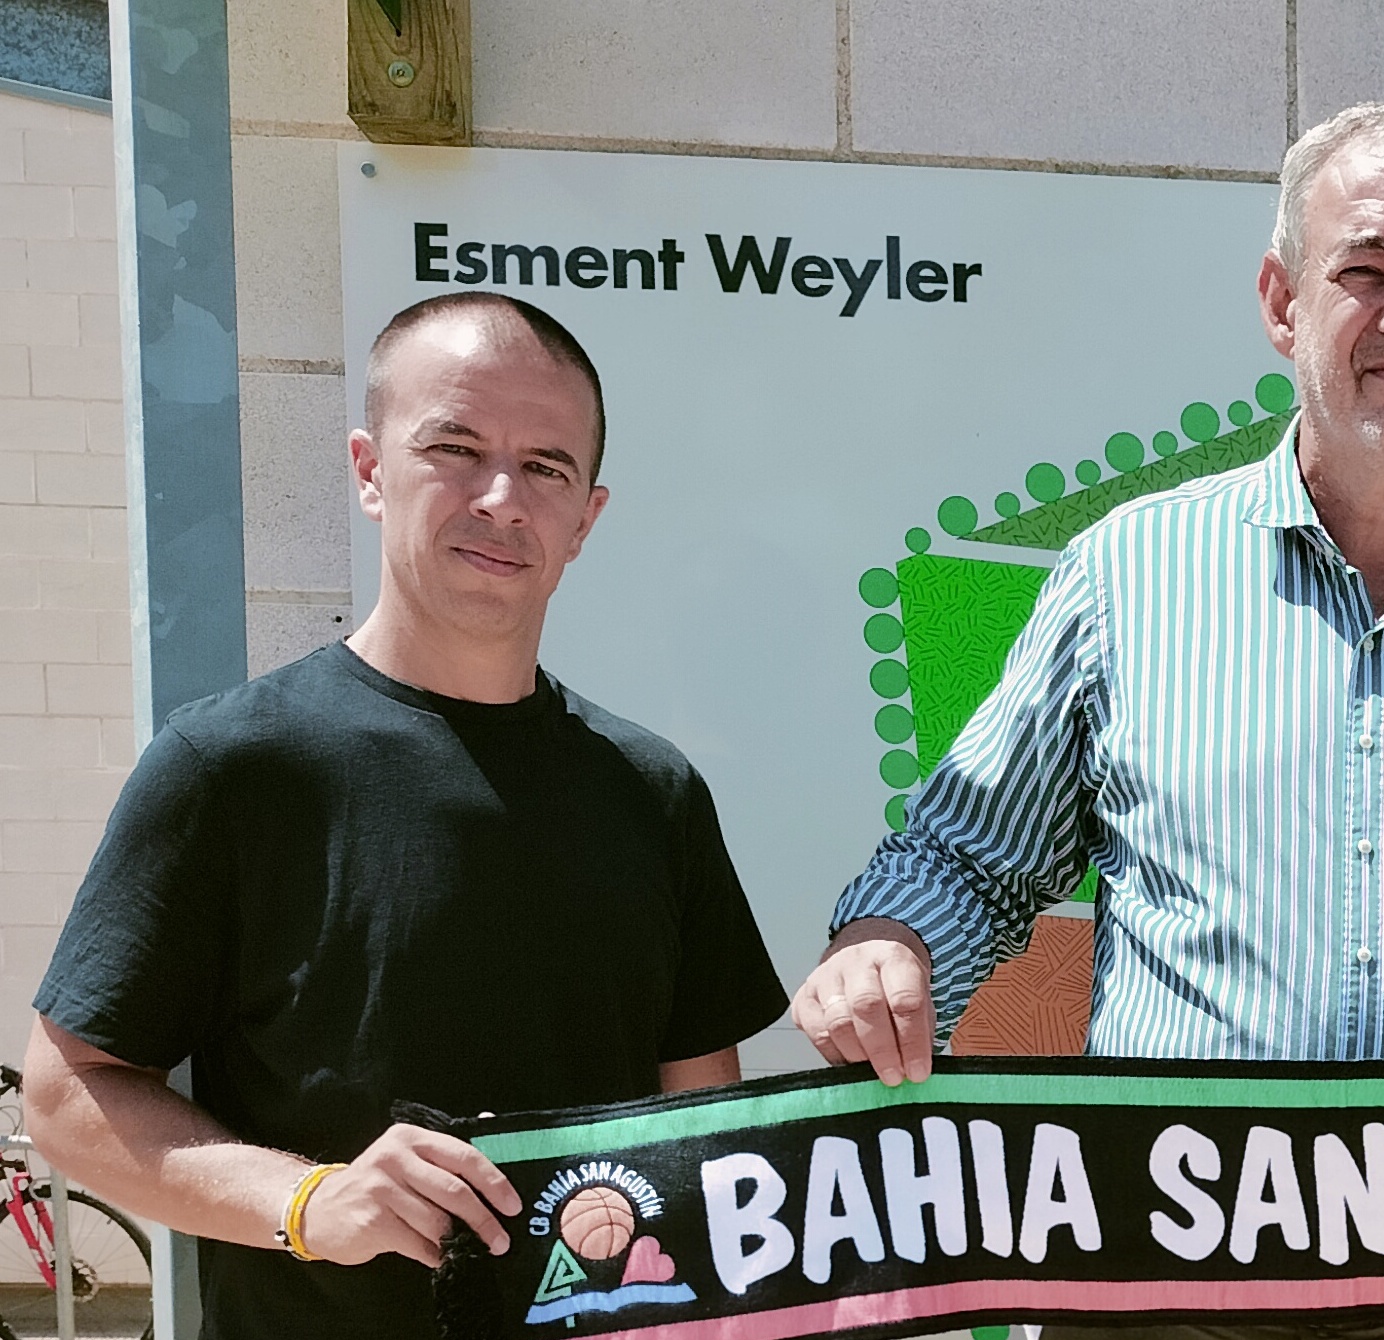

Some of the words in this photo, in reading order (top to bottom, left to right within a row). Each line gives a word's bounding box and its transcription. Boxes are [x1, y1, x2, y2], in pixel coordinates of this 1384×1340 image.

[414, 222, 685, 291] Esment
[704, 233, 982, 317] Weyler
[529, 1216, 550, 1236] CB
[579, 1161, 612, 1183] SAN
[701, 1116, 1102, 1295] BAHIA
